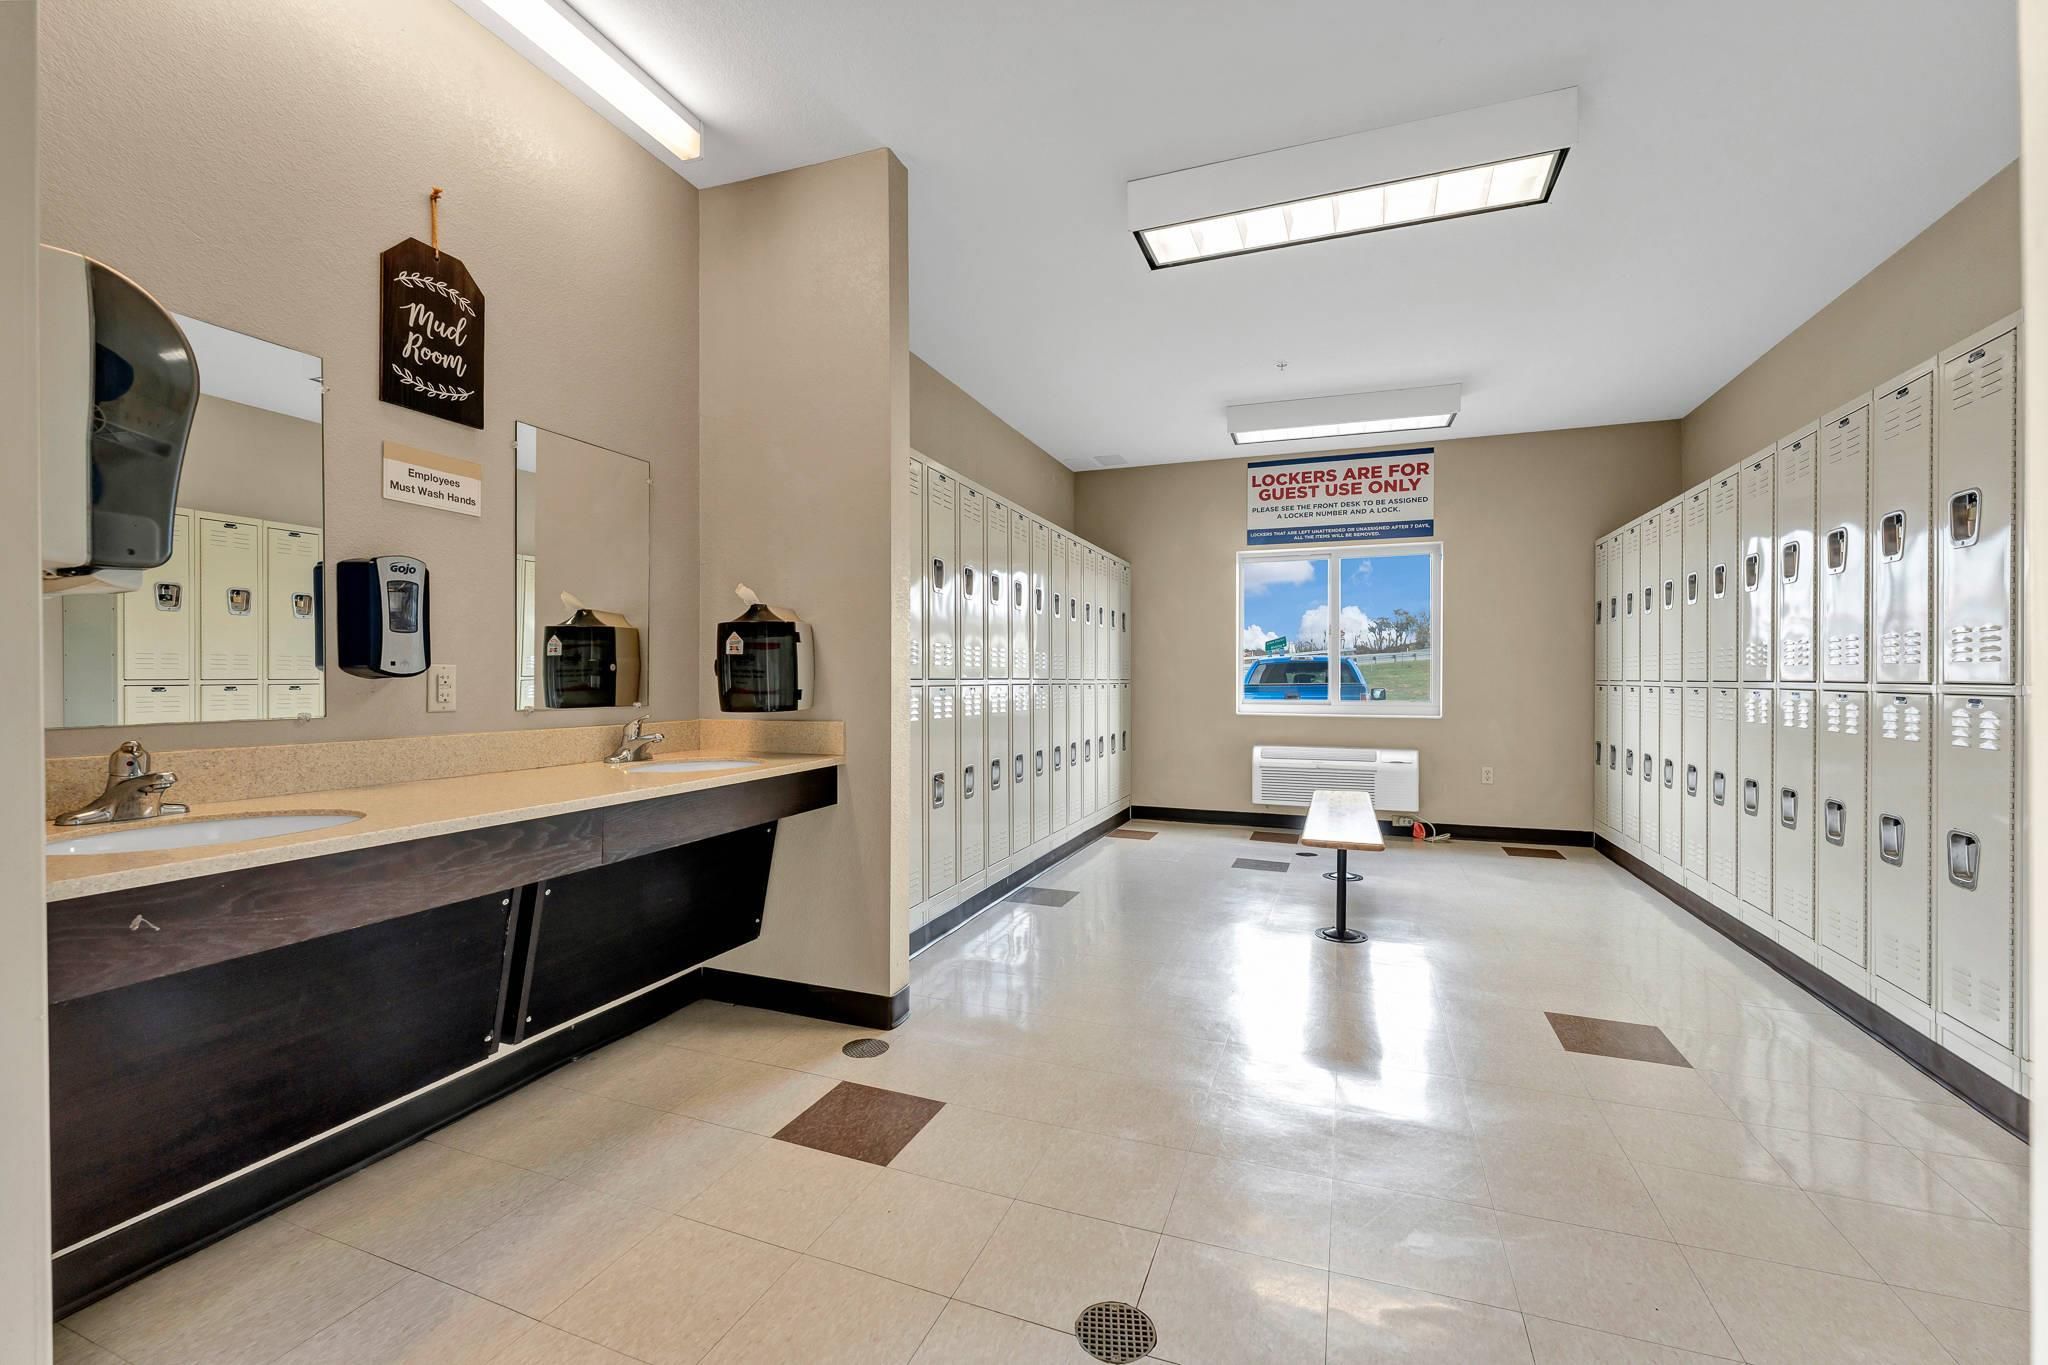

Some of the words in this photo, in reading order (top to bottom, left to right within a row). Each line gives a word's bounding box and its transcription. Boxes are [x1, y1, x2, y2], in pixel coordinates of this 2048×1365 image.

[399, 302, 467, 347] Mud
[402, 331, 467, 377] Room
[408, 467, 460, 488] Employees
[1251, 469, 1337, 488] LOCKERS
[1342, 465, 1382, 481] ARE
[1388, 462, 1430, 477] FOR
[389, 479, 415, 493] Must
[417, 486, 444, 500] Wash
[447, 492, 476, 506] Hands
[1258, 485, 1320, 501] GUEST
[1325, 482, 1362, 497] USE
[1368, 477, 1422, 494] ONLY
[1252, 505, 1279, 513] PLEASE
[1388, 496, 1429, 505] ASSIGNED
[1284, 511, 1313, 519] LOCKER
[1316, 509, 1348, 517] NUMBER
[1377, 506, 1401, 514] LOCK.
